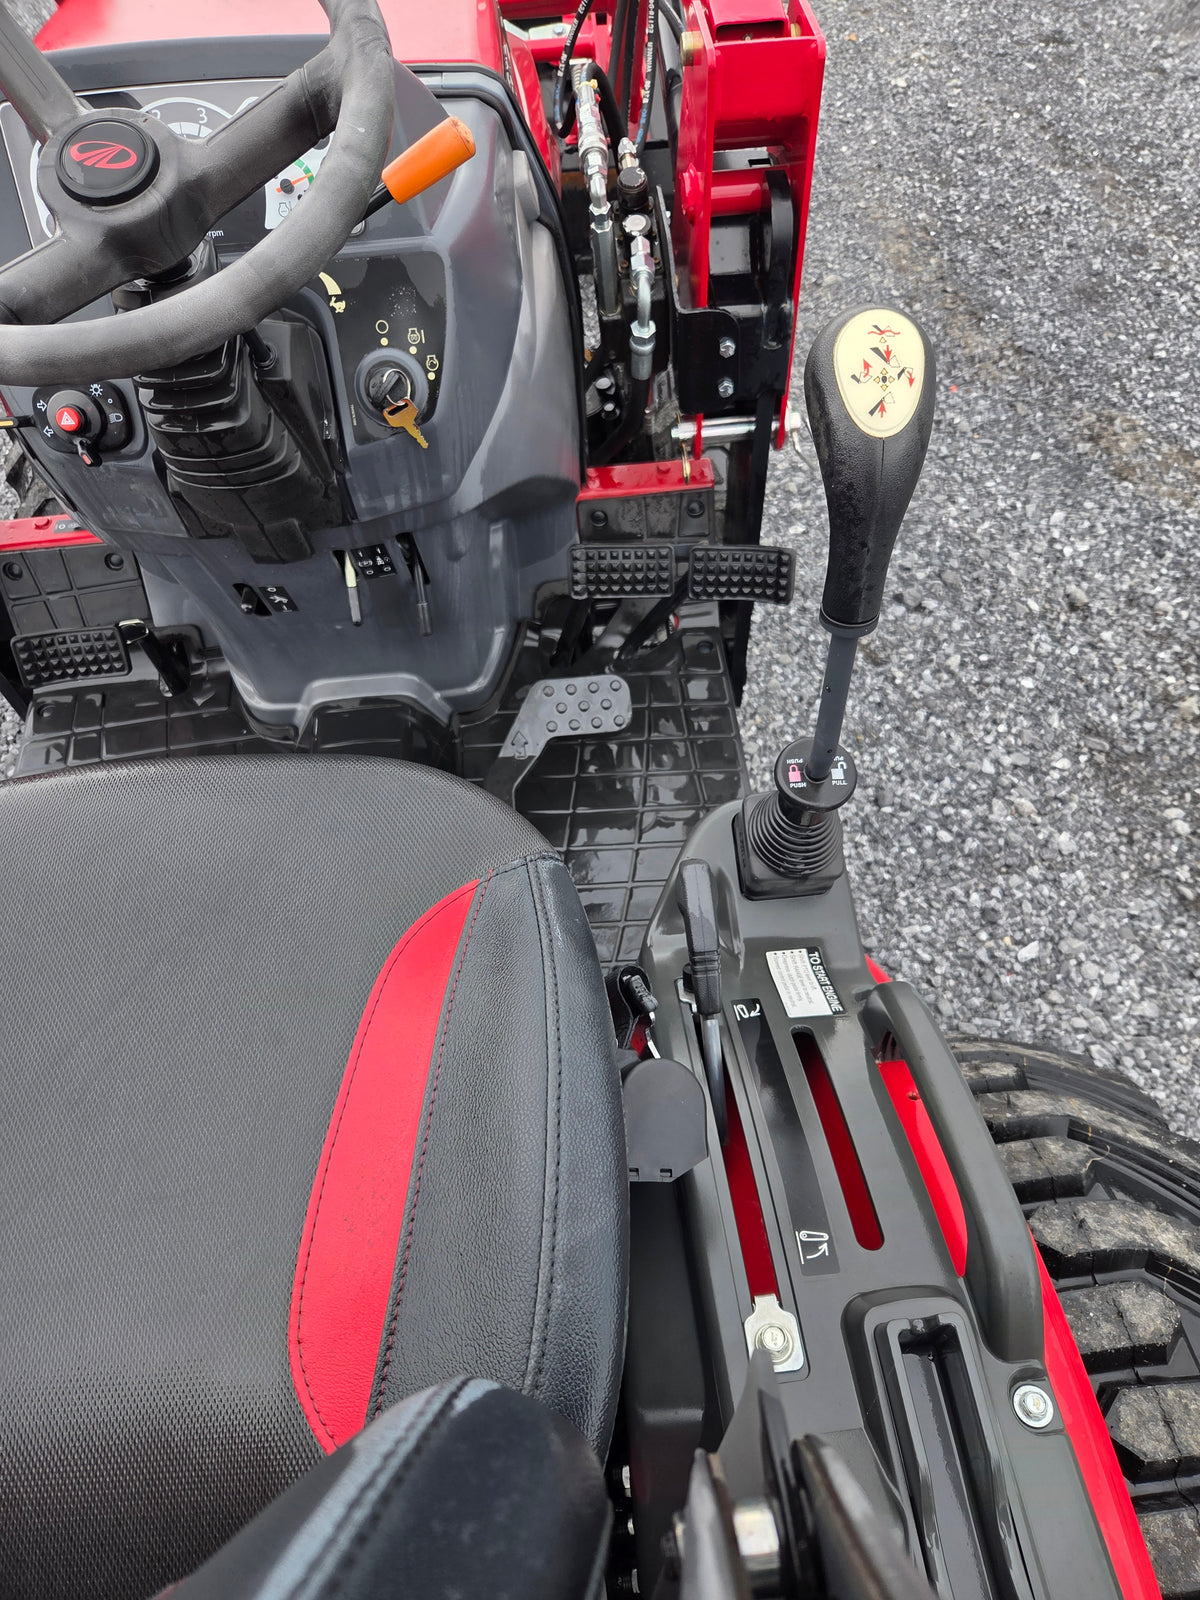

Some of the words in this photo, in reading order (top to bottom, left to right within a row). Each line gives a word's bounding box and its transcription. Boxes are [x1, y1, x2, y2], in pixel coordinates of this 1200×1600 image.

[196, 107, 208, 124] 3
[208, 230, 224, 239] rpm
[808, 952, 821, 964] TO
[813, 965, 831, 985] START
[821, 985, 844, 1012] ENGINE
